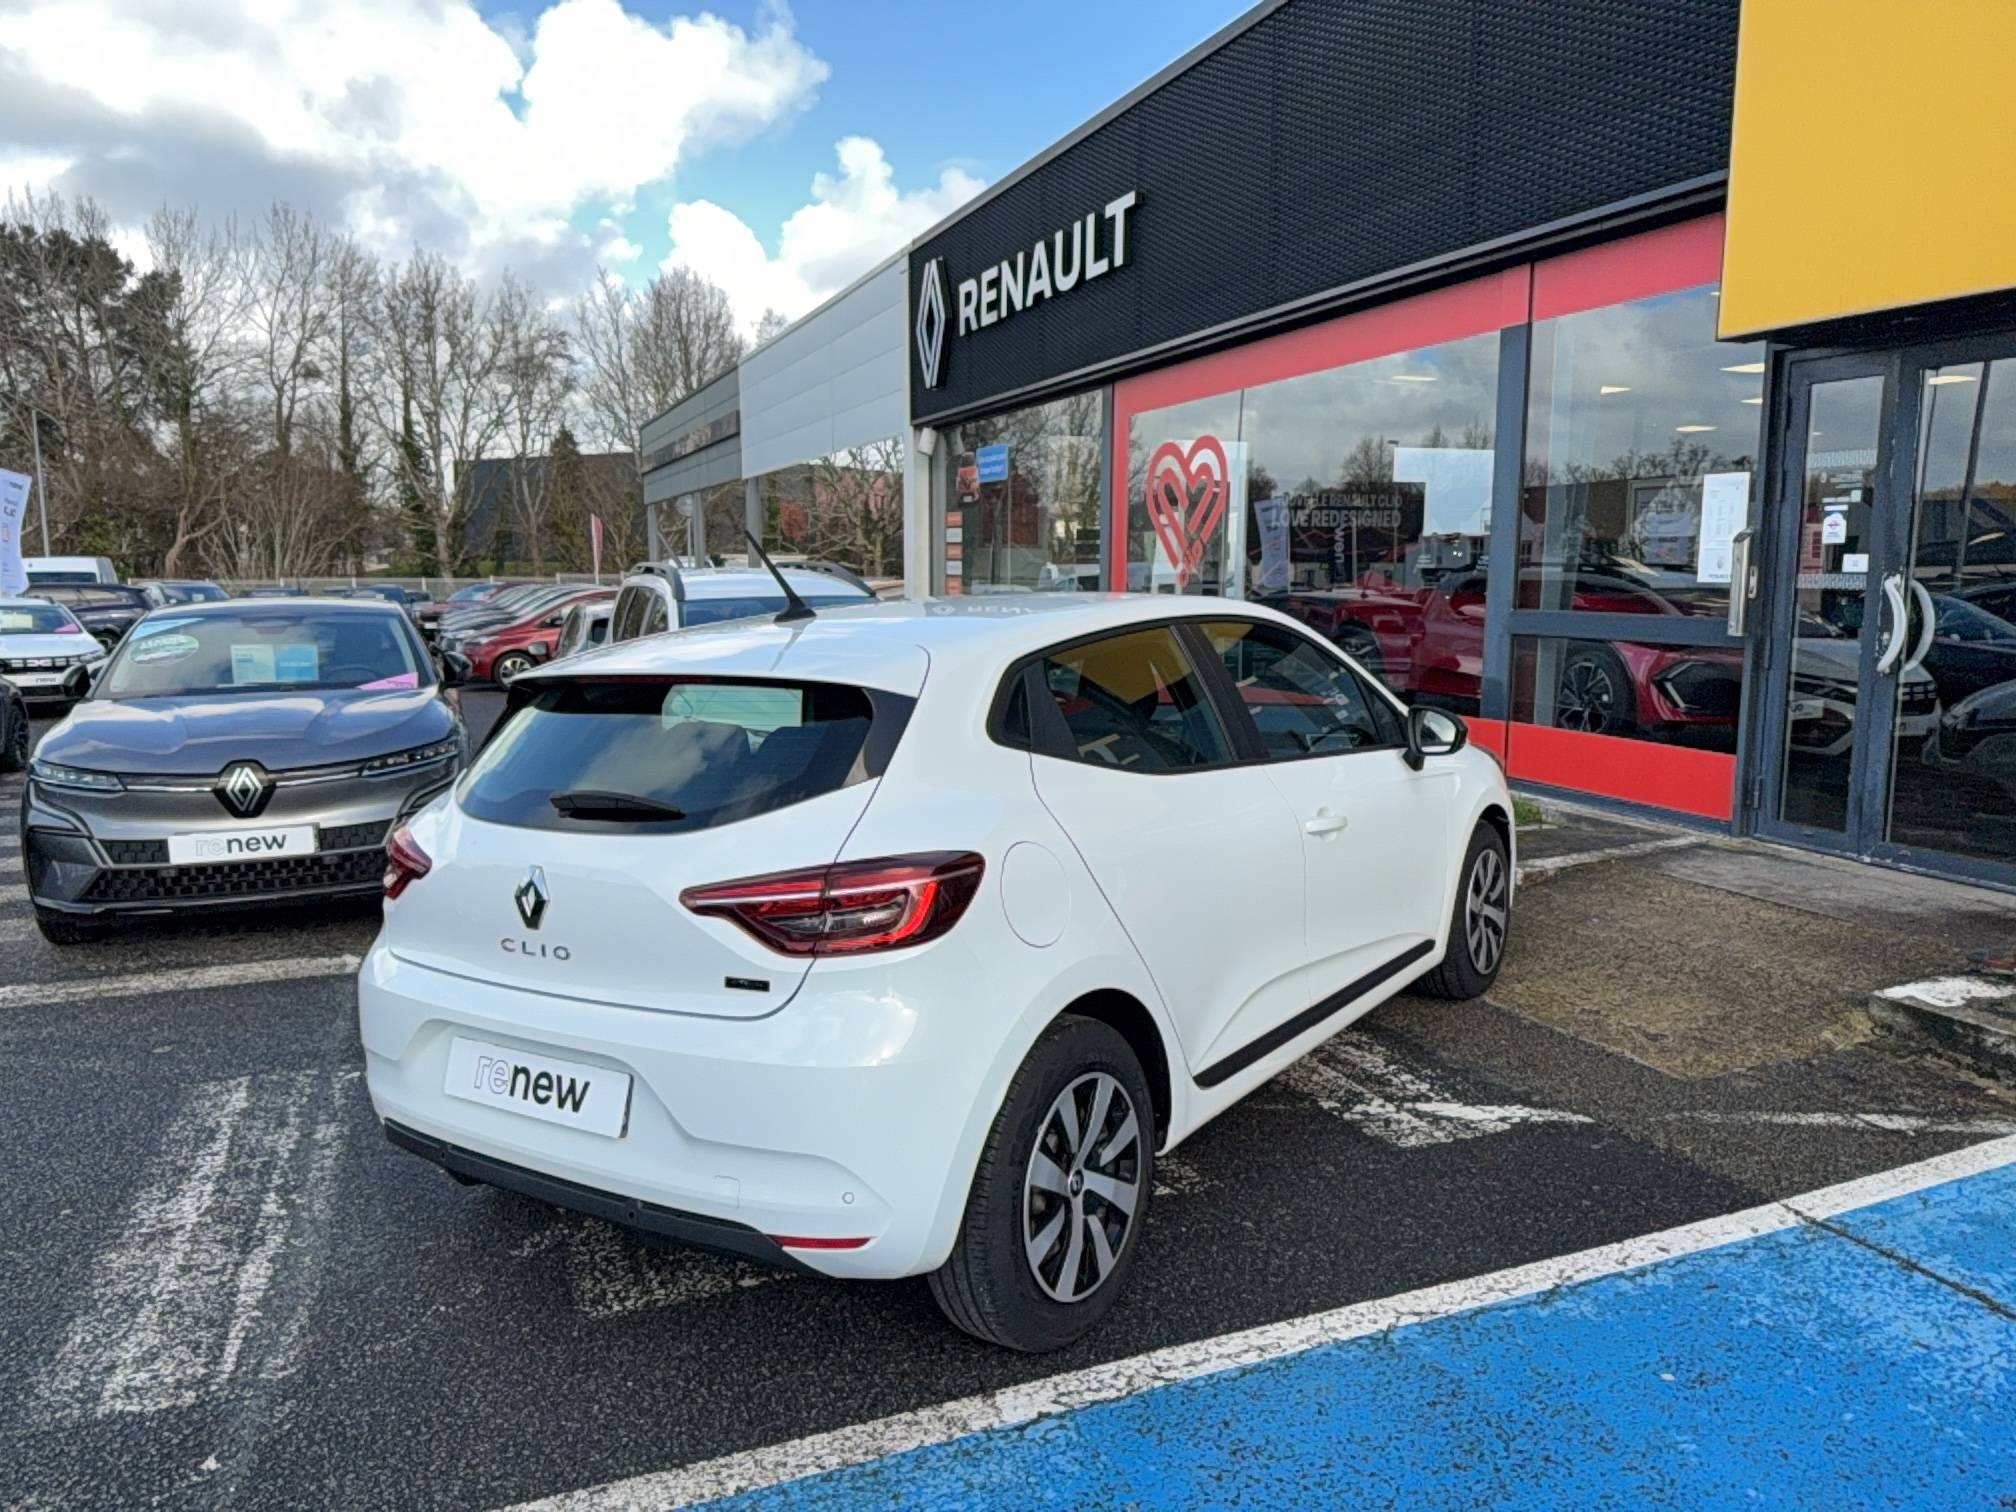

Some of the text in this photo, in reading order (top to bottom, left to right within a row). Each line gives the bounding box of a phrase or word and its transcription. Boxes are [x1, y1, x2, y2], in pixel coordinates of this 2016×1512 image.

[959, 190, 1137, 337] RENAULT
[1271, 508, 1309, 528] LOVE
[1311, 509, 1402, 528] REDESIGNED
[194, 833, 287, 857] renew
[500, 937, 571, 961] CLIO
[474, 1055, 591, 1114] renew
